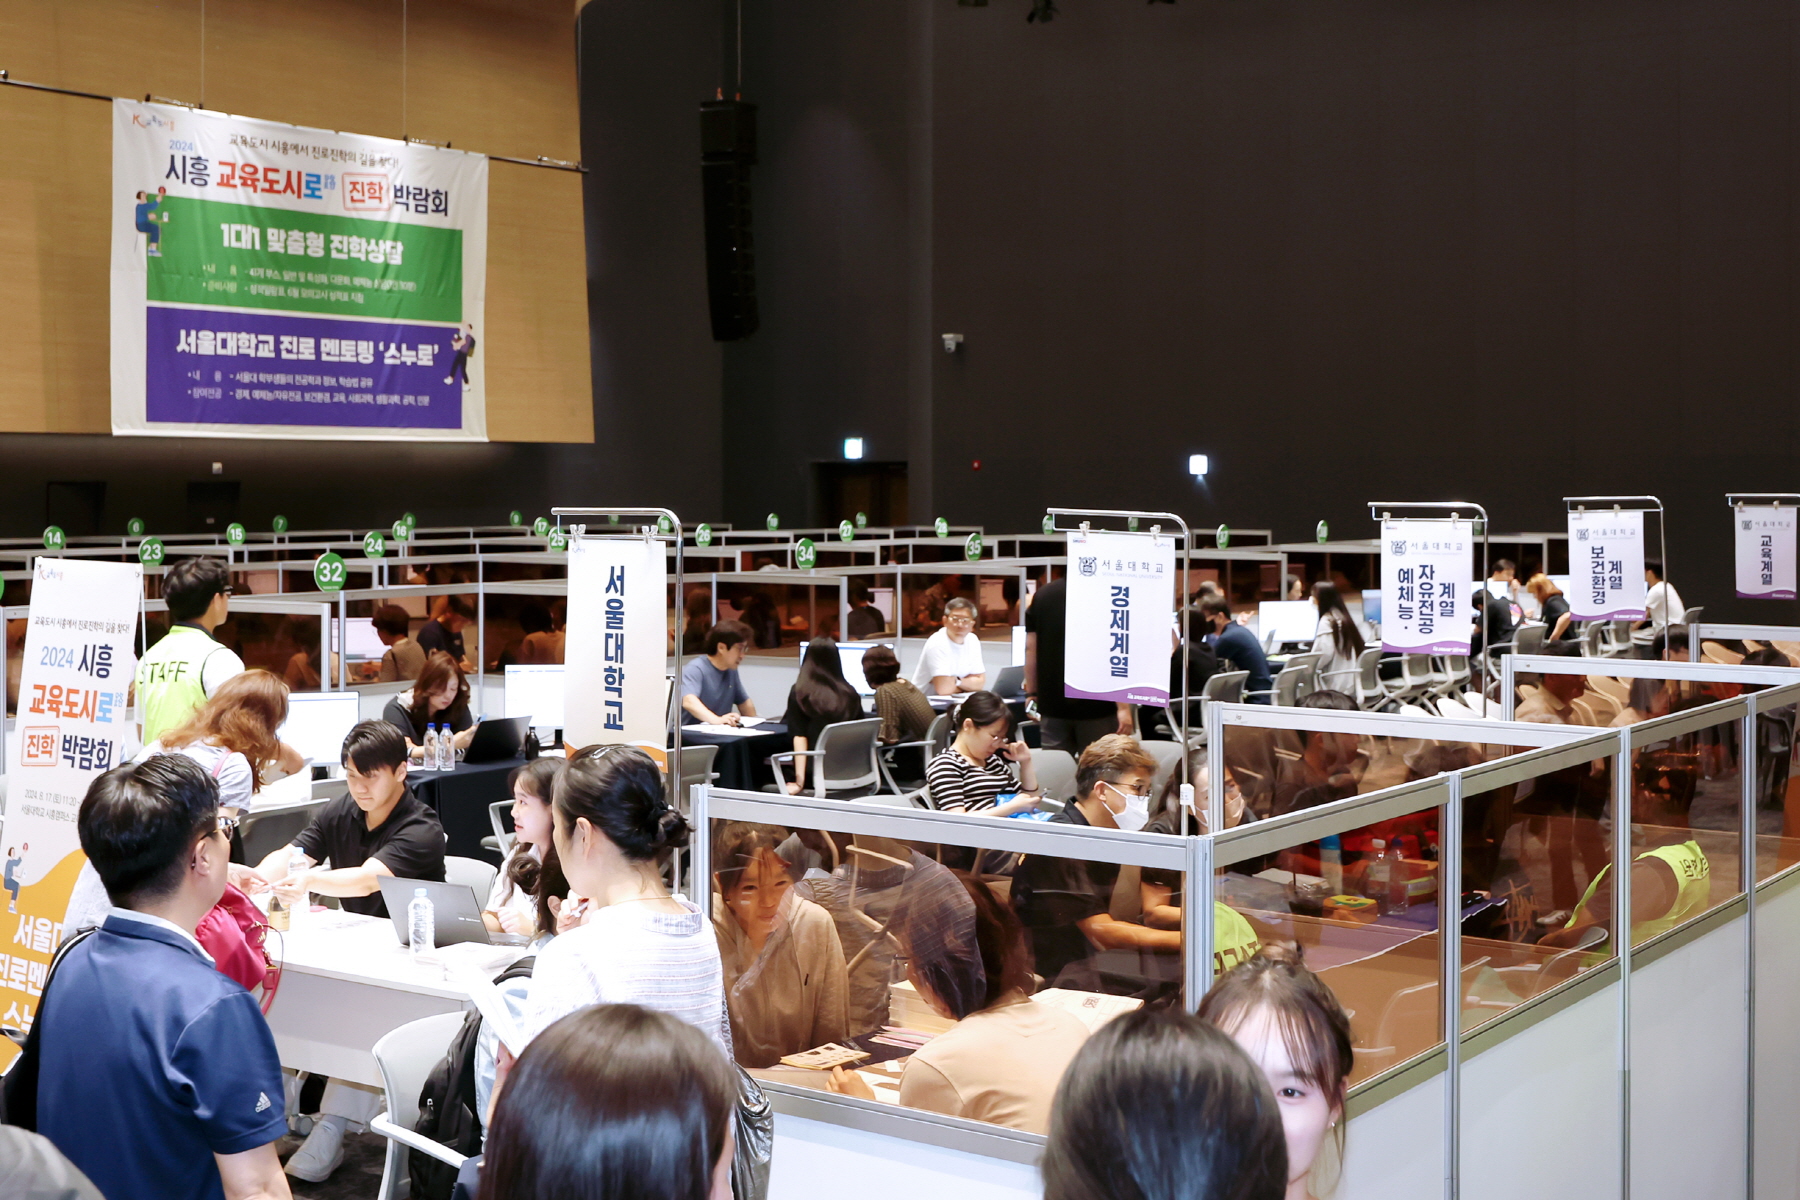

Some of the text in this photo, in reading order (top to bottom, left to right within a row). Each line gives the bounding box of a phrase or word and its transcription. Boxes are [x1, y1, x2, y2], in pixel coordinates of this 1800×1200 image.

[169, 139, 194, 152] 2024
[229, 134, 268, 150] 교육도시
[271, 140, 309, 156] 시흥에서
[311, 145, 357, 163] 진로진학의
[359, 152, 377, 166] 길을
[165, 154, 210, 187] 시흥
[349, 180, 384, 204] 진학
[394, 184, 449, 216] 박람회
[220, 223, 404, 265] 1대1 맞춤형 진학상담
[176, 329, 276, 358] 서울대학교
[279, 335, 316, 361] 진로
[320, 337, 375, 365] 멘토링
[235, 371, 258, 384] 서울대
[192, 386, 222, 400] 참여전공
[277, 519, 284, 529] 7
[395, 525, 407, 537] 16
[538, 521, 547, 532] 17
[842, 525, 853, 537] 27
[47, 531, 62, 545] 14
[230, 528, 243, 541] 15
[551, 532, 565, 546] 25
[698, 529, 711, 542] 26
[142, 543, 162, 560] 23
[366, 538, 384, 553] 24
[967, 540, 981, 555] 35
[1410, 541, 1463, 551] 서울대학교
[798, 546, 815, 561] 34
[1760, 535, 1773, 586] 교육계열
[319, 561, 343, 582] 32
[1101, 559, 1164, 574] 서울대학교
[1590, 546, 1606, 605] 보건환경
[1608, 560, 1623, 590] 계열
[1418, 564, 1436, 635] 자유전공
[1438, 582, 1456, 618] 계열
[35, 616, 56, 627] 교육도시
[56, 618, 78, 630] 시흥에서
[78, 620, 104, 632] 진로진학의
[106, 622, 116, 634] 길을
[1109, 584, 1131, 679] 경제계열
[603, 565, 625, 732] 서울대학교
[40, 643, 114, 679] 2024 시흥
[27, 733, 113, 772] 진학 박람회
[21, 804, 45, 818] 서울대학교
